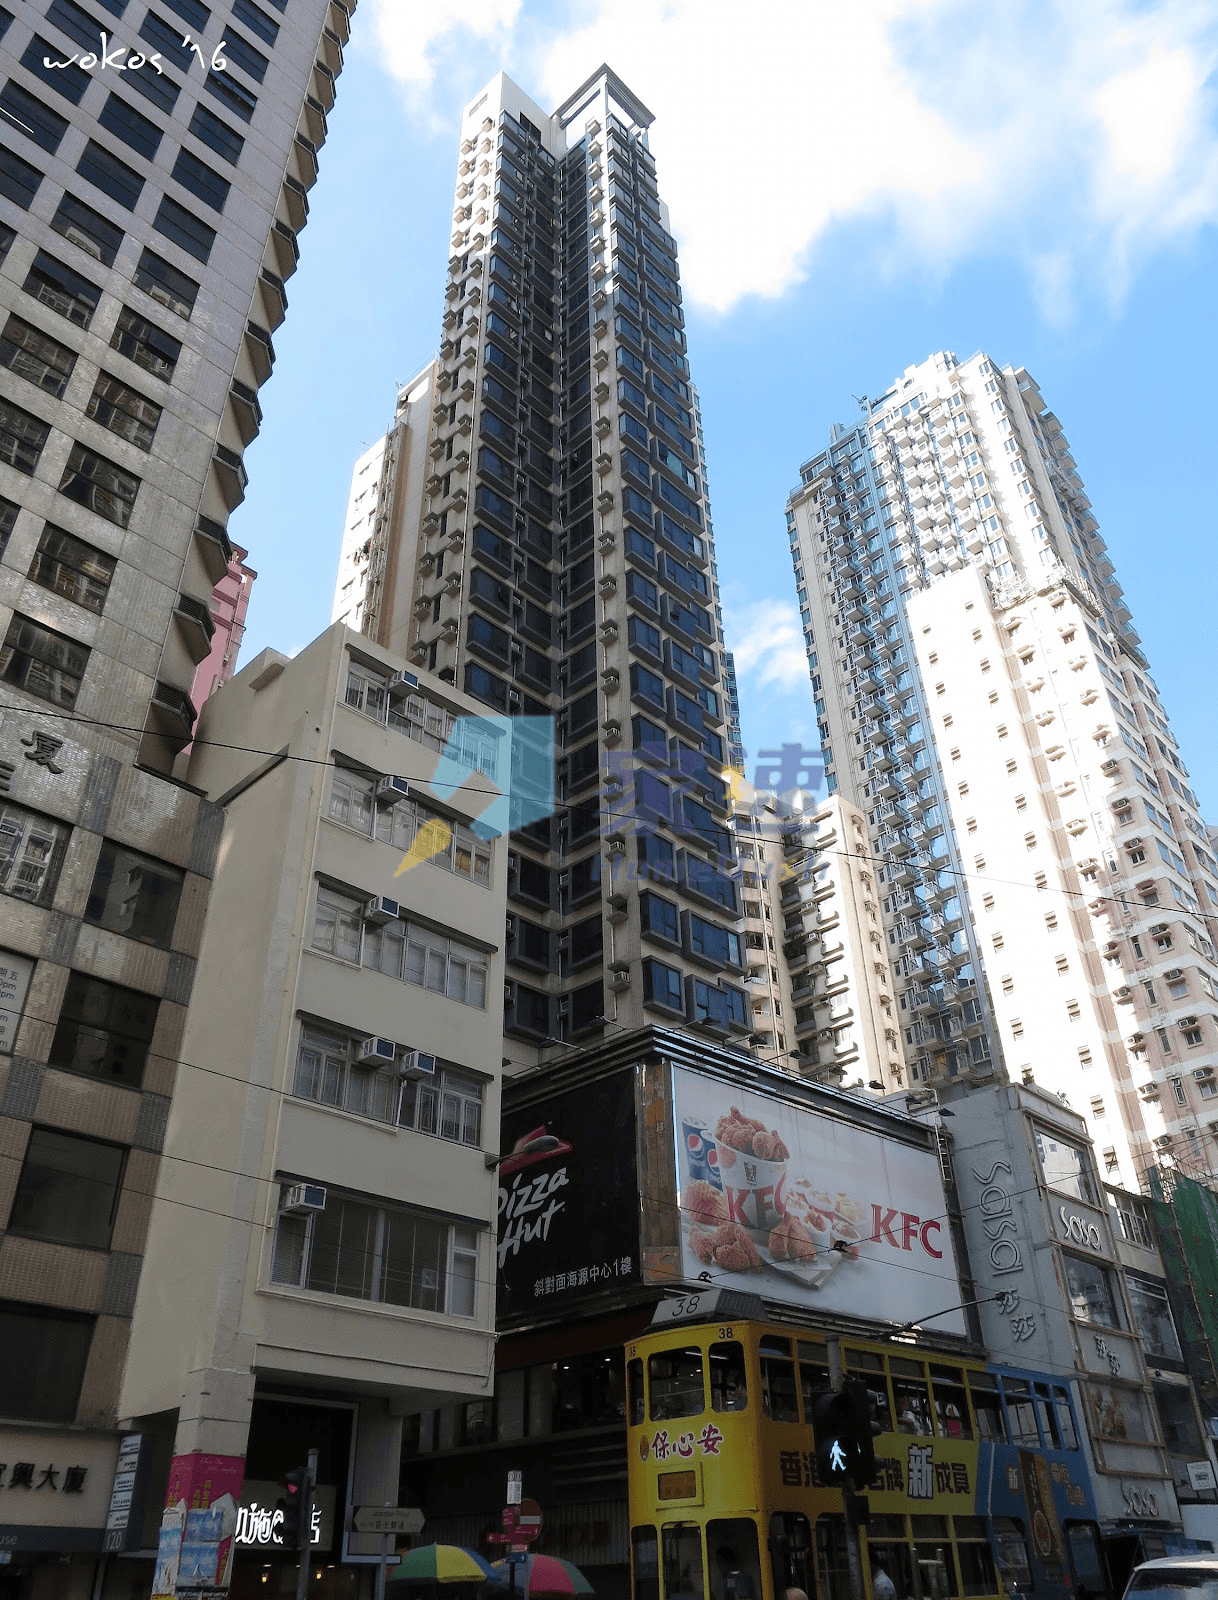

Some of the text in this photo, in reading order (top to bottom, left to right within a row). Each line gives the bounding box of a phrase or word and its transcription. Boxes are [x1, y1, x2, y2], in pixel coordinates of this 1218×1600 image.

[497, 1199, 566, 1269] Hut
[870, 1203, 943, 1259] KFC
[671, 1295, 700, 1318] 38
[718, 1327, 733, 1340] 38
[651, 1423, 724, 1460] 保心安
[106, 1531, 122, 1550] 120
